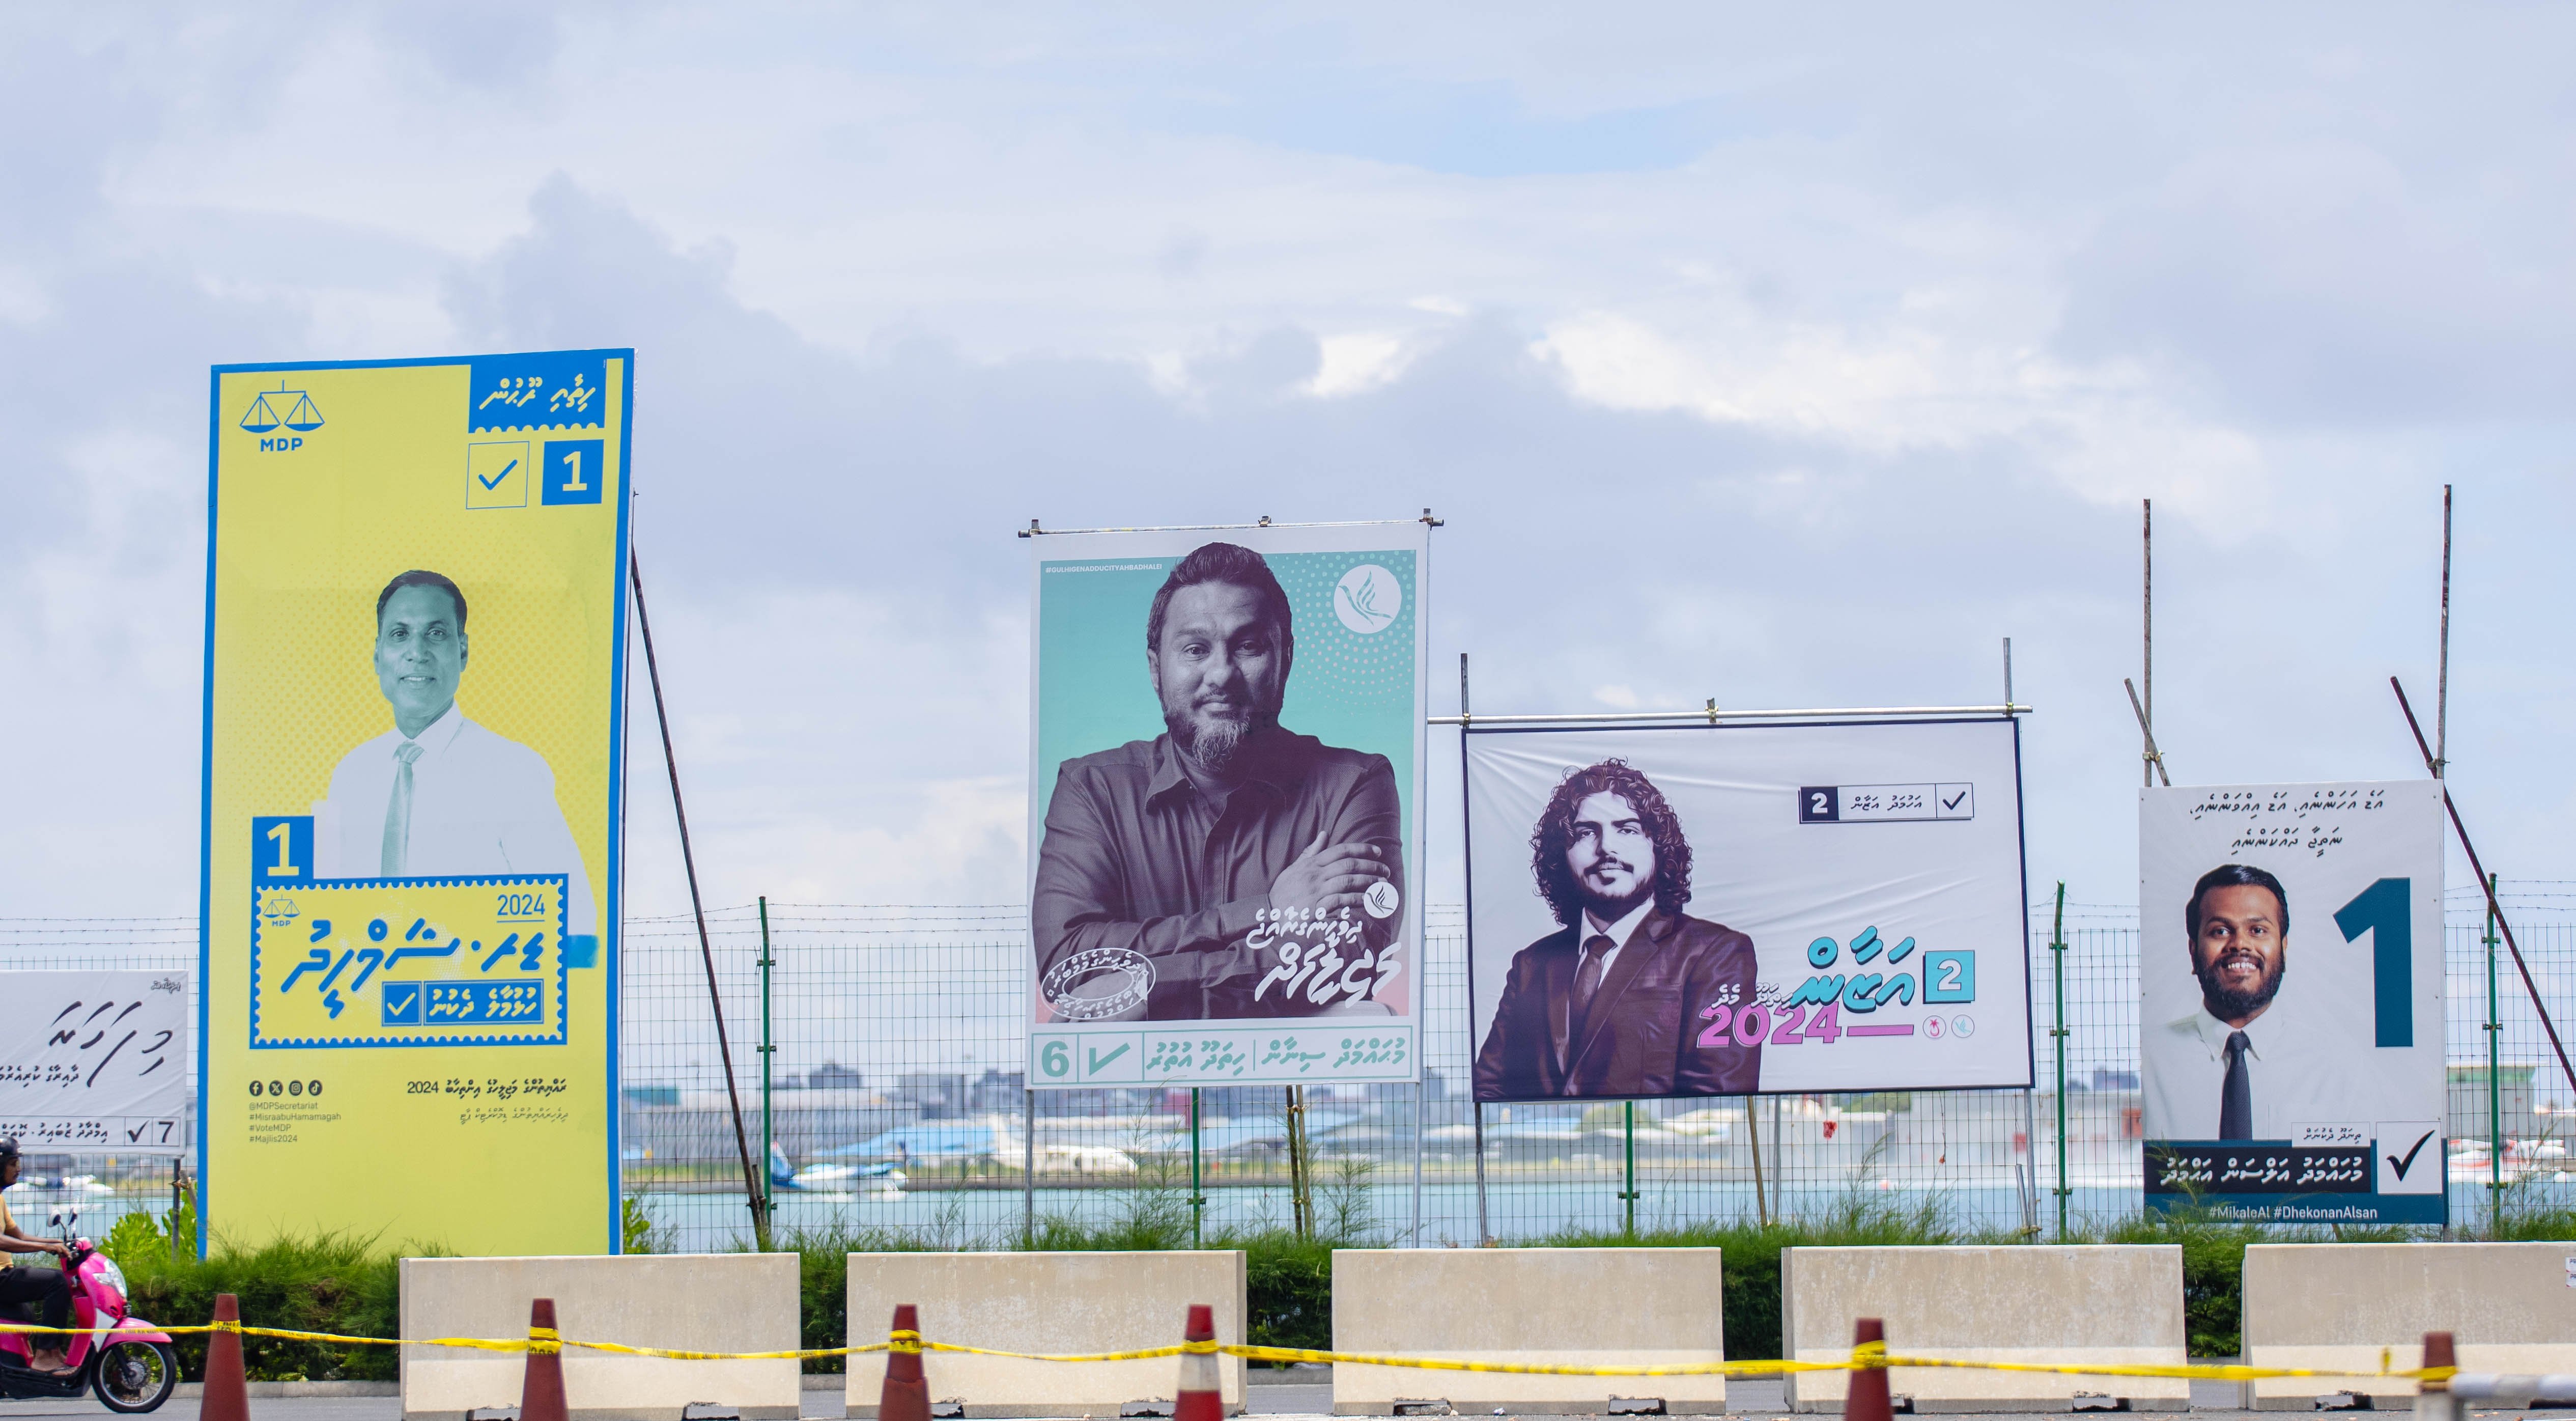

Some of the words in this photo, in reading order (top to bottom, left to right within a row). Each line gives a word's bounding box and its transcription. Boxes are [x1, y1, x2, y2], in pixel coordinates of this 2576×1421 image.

[260, 437, 303, 452] MDP
[562, 451, 587, 492] 1
[1045, 564, 1163, 573] #GULHIGENADDUCITYAHBADHALEI
[1811, 792, 1828, 814] 2
[266, 822, 299, 877] 1
[497, 893, 545, 916] 2024
[2333, 877, 2413, 1047] 1
[1937, 958, 1962, 991] 2
[1696, 1001, 1842, 1048] 2024
[1041, 1040, 1069, 1077] 6
[407, 1081, 439, 1093] 2024
[249, 1102, 318, 1110] @MDPSecretariat
[249, 1113, 342, 1122] #MisraabuHamamagah
[159, 1121, 175, 1143] 7
[249, 1134, 297, 1144] #Majlis2024
[2209, 1206, 2270, 1219] #MikaleAl
[2274, 1205, 2377, 1219] #DhekonanAlsan
